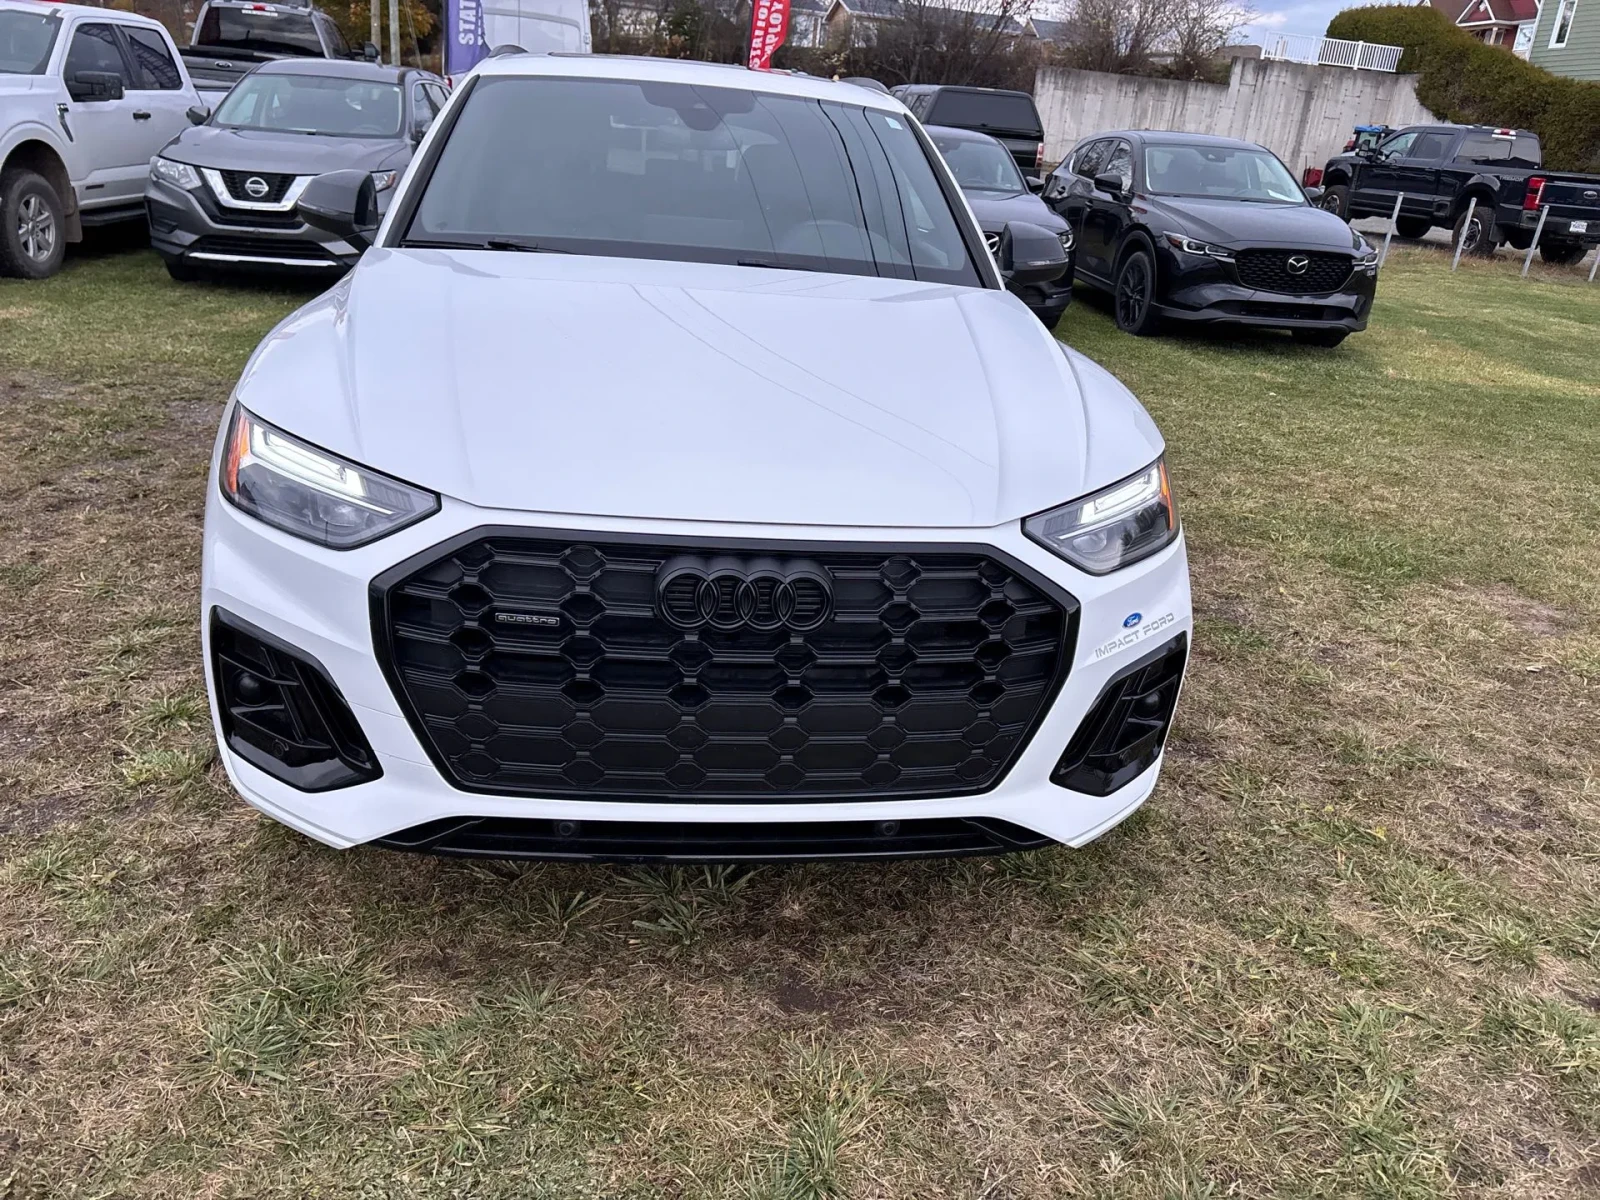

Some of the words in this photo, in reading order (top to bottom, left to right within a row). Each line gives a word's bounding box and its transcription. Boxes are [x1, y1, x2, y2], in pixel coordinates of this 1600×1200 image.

[458, 0, 476, 45] STAT
[498, 615, 557, 624] quattro
[1095, 630, 1140, 658] IMPACT
[1142, 612, 1175, 635] FORD
